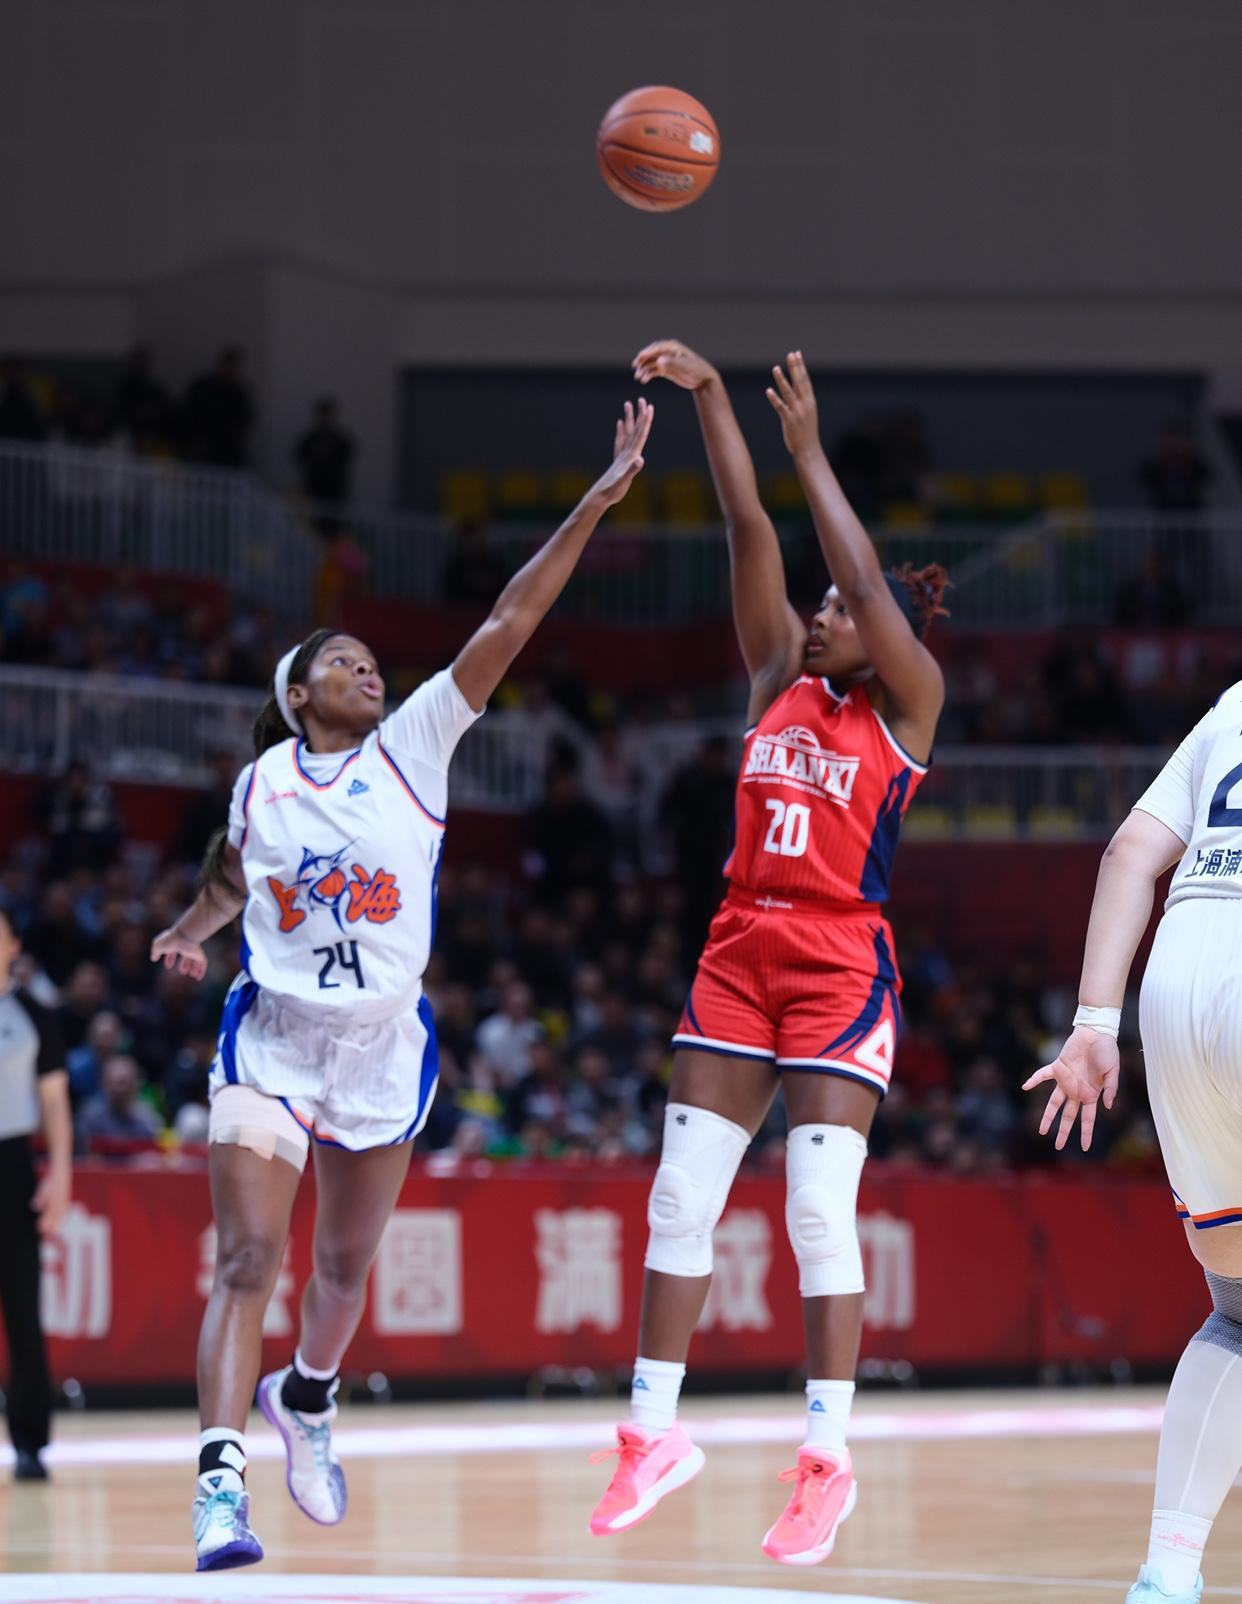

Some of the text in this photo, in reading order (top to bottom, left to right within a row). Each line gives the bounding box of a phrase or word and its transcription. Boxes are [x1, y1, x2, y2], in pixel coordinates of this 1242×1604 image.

[744, 740, 859, 801] SHAANXI
[764, 799, 811, 857] 20
[1184, 848, 1242, 878] 上海浦
[267, 863, 402, 933] 上海
[313, 940, 365, 989] 24
